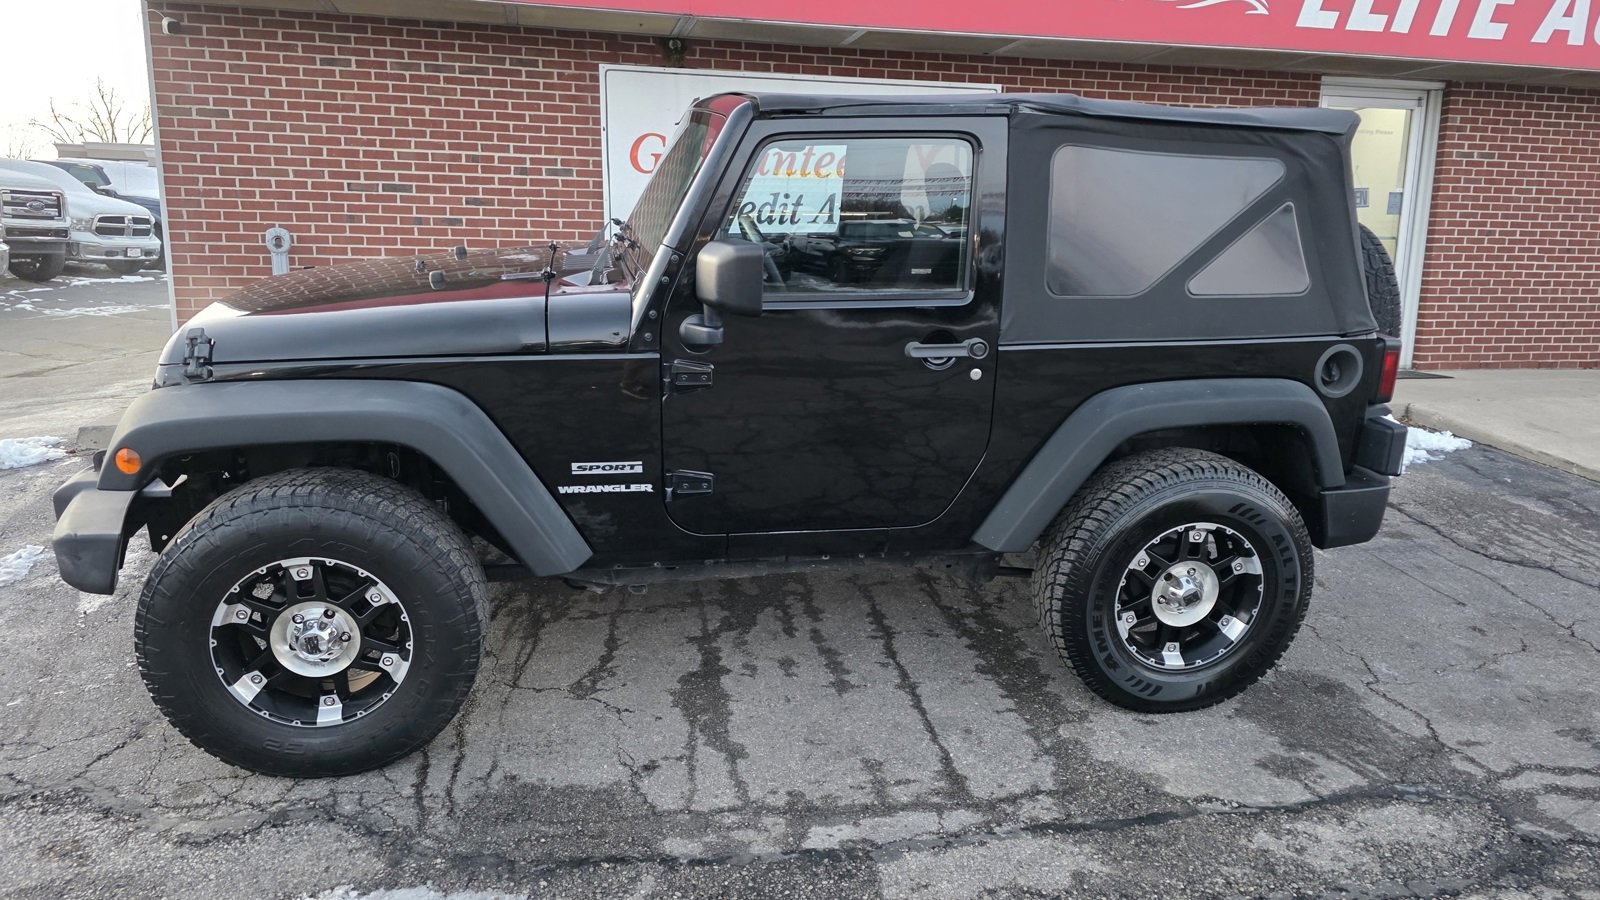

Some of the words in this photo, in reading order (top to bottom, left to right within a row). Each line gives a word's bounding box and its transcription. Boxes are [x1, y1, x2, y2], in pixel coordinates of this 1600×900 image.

[1530, 0, 1600, 46] A
[574, 463, 641, 473] SPORT
[558, 484, 654, 494] WRANGLER
